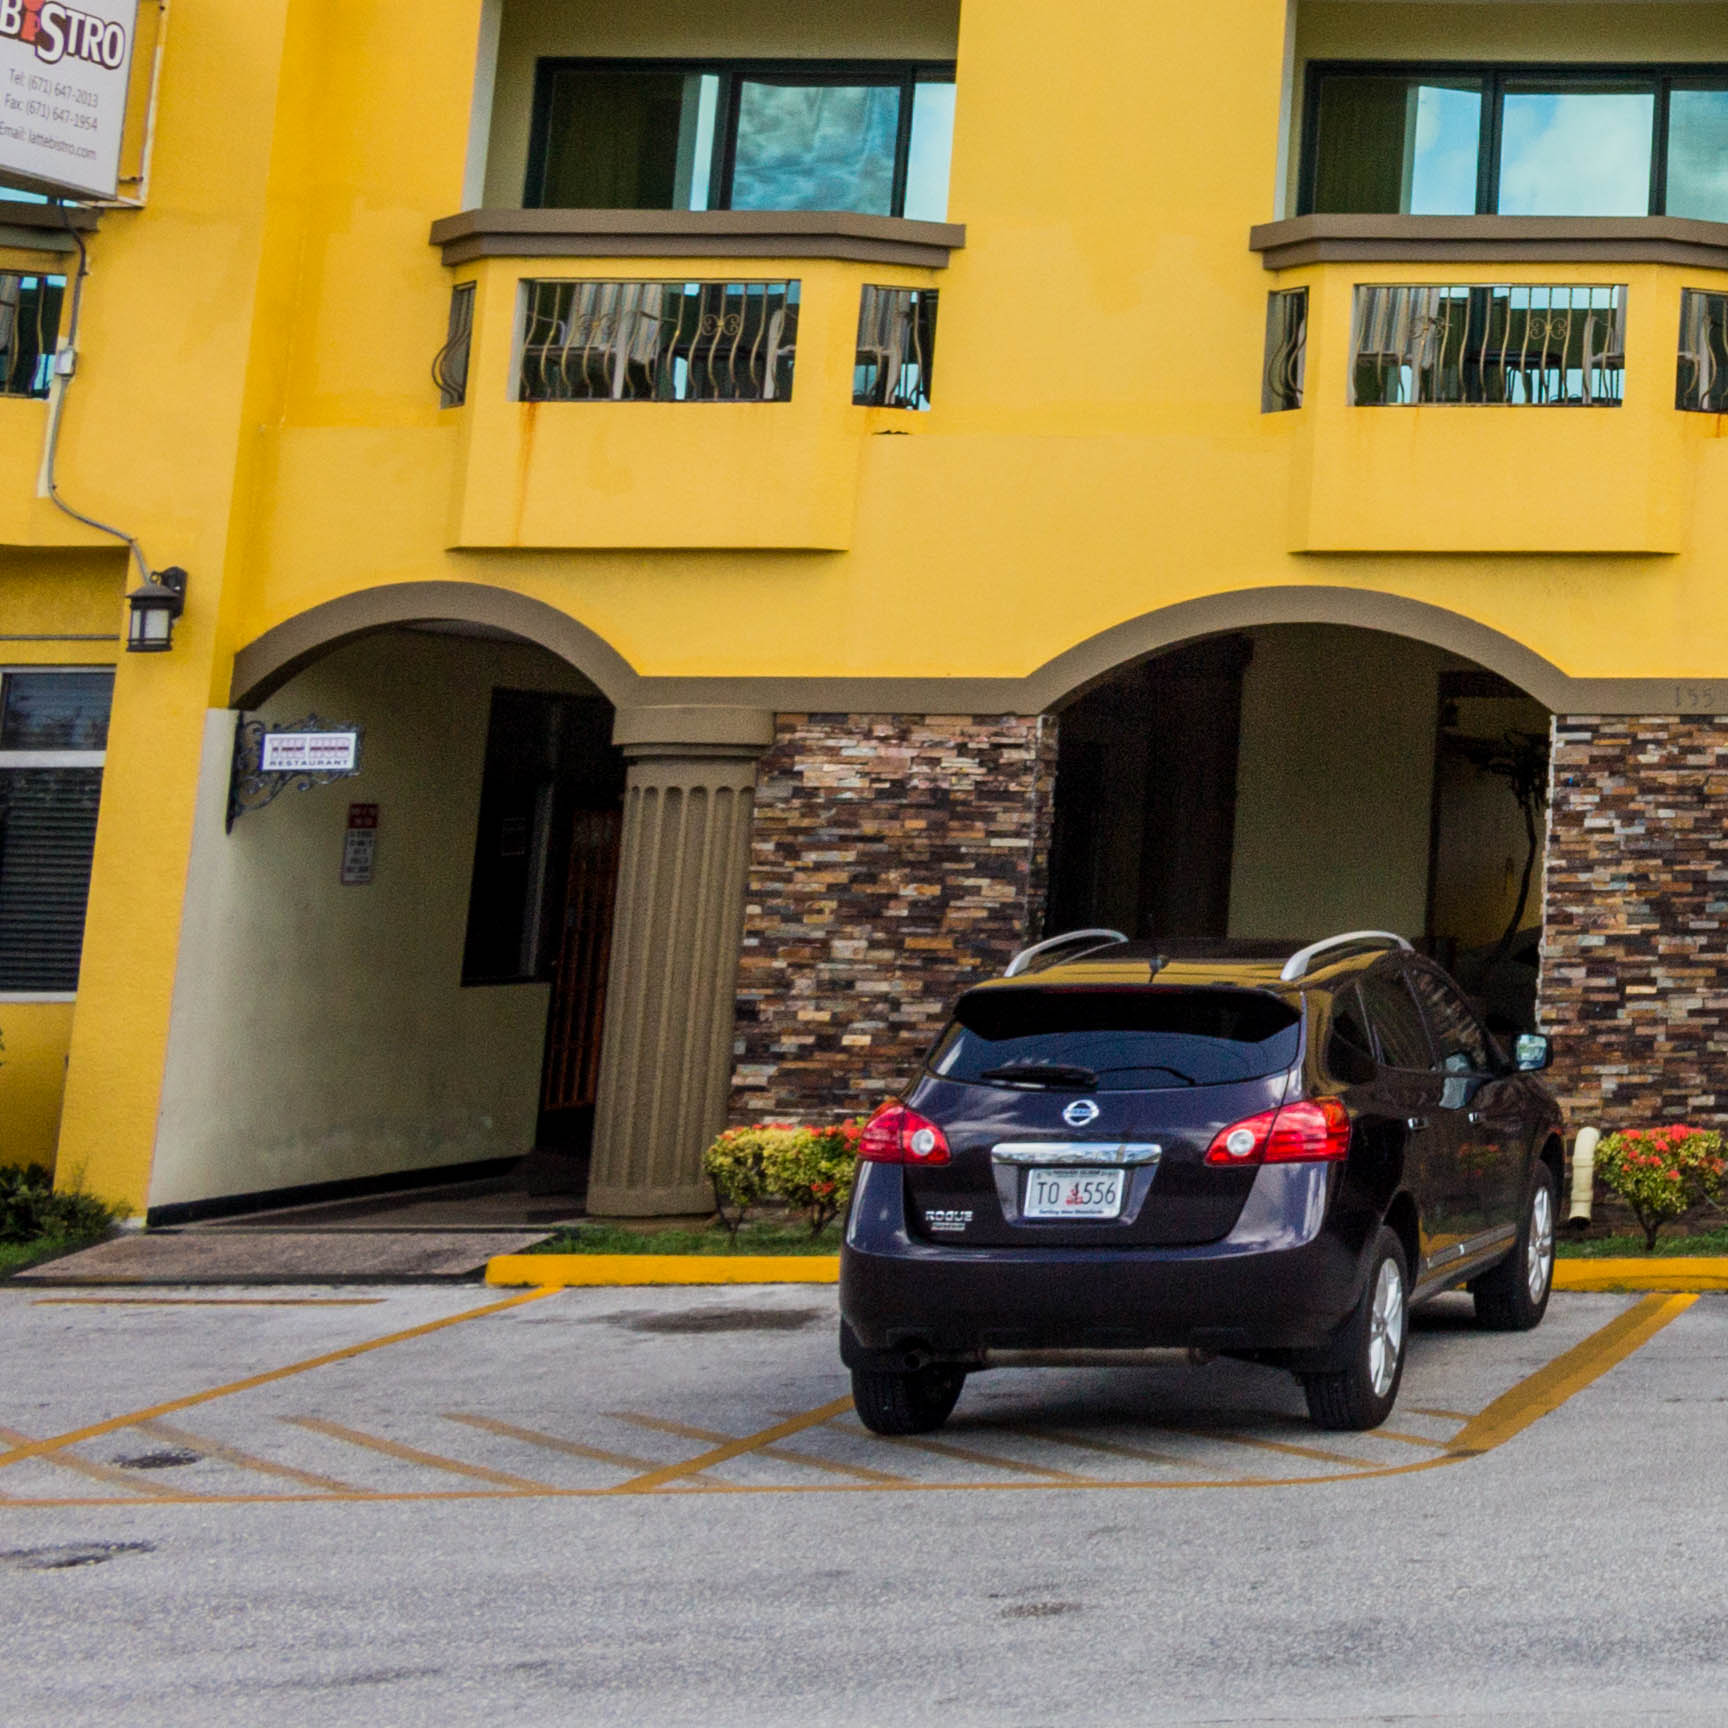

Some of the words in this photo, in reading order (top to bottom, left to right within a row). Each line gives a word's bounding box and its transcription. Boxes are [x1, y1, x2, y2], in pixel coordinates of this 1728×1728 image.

[9, 68, 26, 87] Tel:
[28, 73, 53, 96] (671)
[4, 92, 24, 112] Fax:
[26, 100, 51, 121] (671)
[269, 759, 348, 767] RESTAURANT
[925, 1210, 973, 1222] ROGUE
